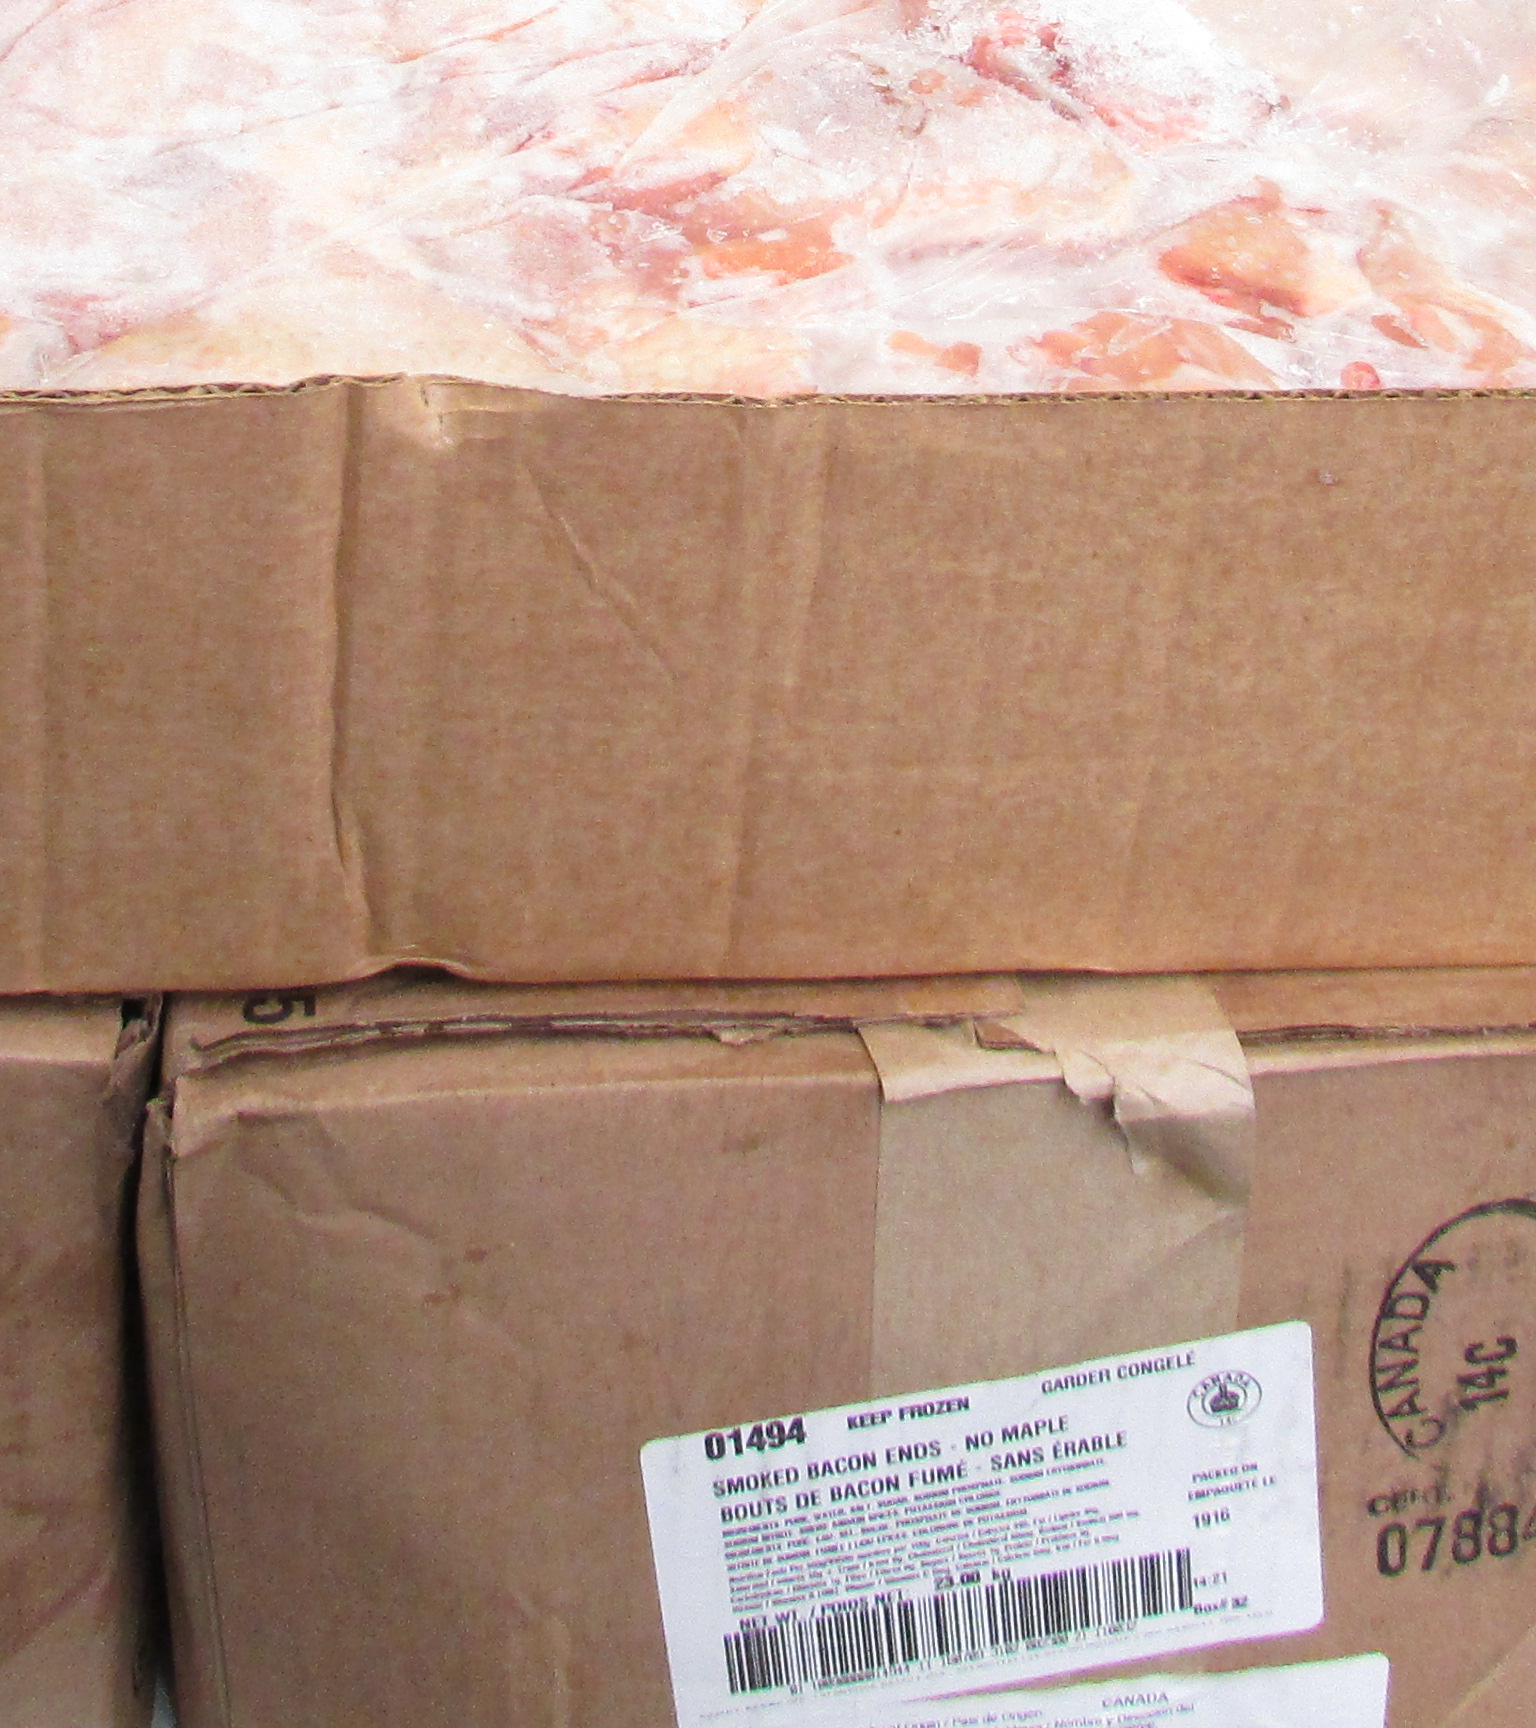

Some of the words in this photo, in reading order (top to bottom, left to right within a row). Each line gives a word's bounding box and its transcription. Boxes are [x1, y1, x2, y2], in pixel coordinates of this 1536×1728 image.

[1378, 1258, 1457, 1451] CANADA
[1457, 1336, 1518, 1413] 14C
[704, 1416, 807, 1461] 01494
[847, 1409, 892, 1430] KEEP
[898, 1396, 970, 1422] FROZEN
[1042, 1368, 1111, 1394] GARDER
[1117, 1350, 1195, 1380] CONGELÉ
[713, 1466, 800, 1498] SMOKED
[807, 1451, 877, 1481] BACON
[886, 1439, 941, 1465] ENDS
[965, 1431, 994, 1452] NO
[1001, 1415, 1069, 1444] MAPLE
[720, 1495, 788, 1523] BOUTS
[795, 1491, 821, 1509] DE
[830, 1475, 900, 1503] BACON
[908, 1458, 969, 1488] FUMÉ
[991, 1446, 1045, 1472] SANS
[1052, 1430, 1127, 1460] ÉRABLE
[1102, 1692, 1170, 1710] CANADA
